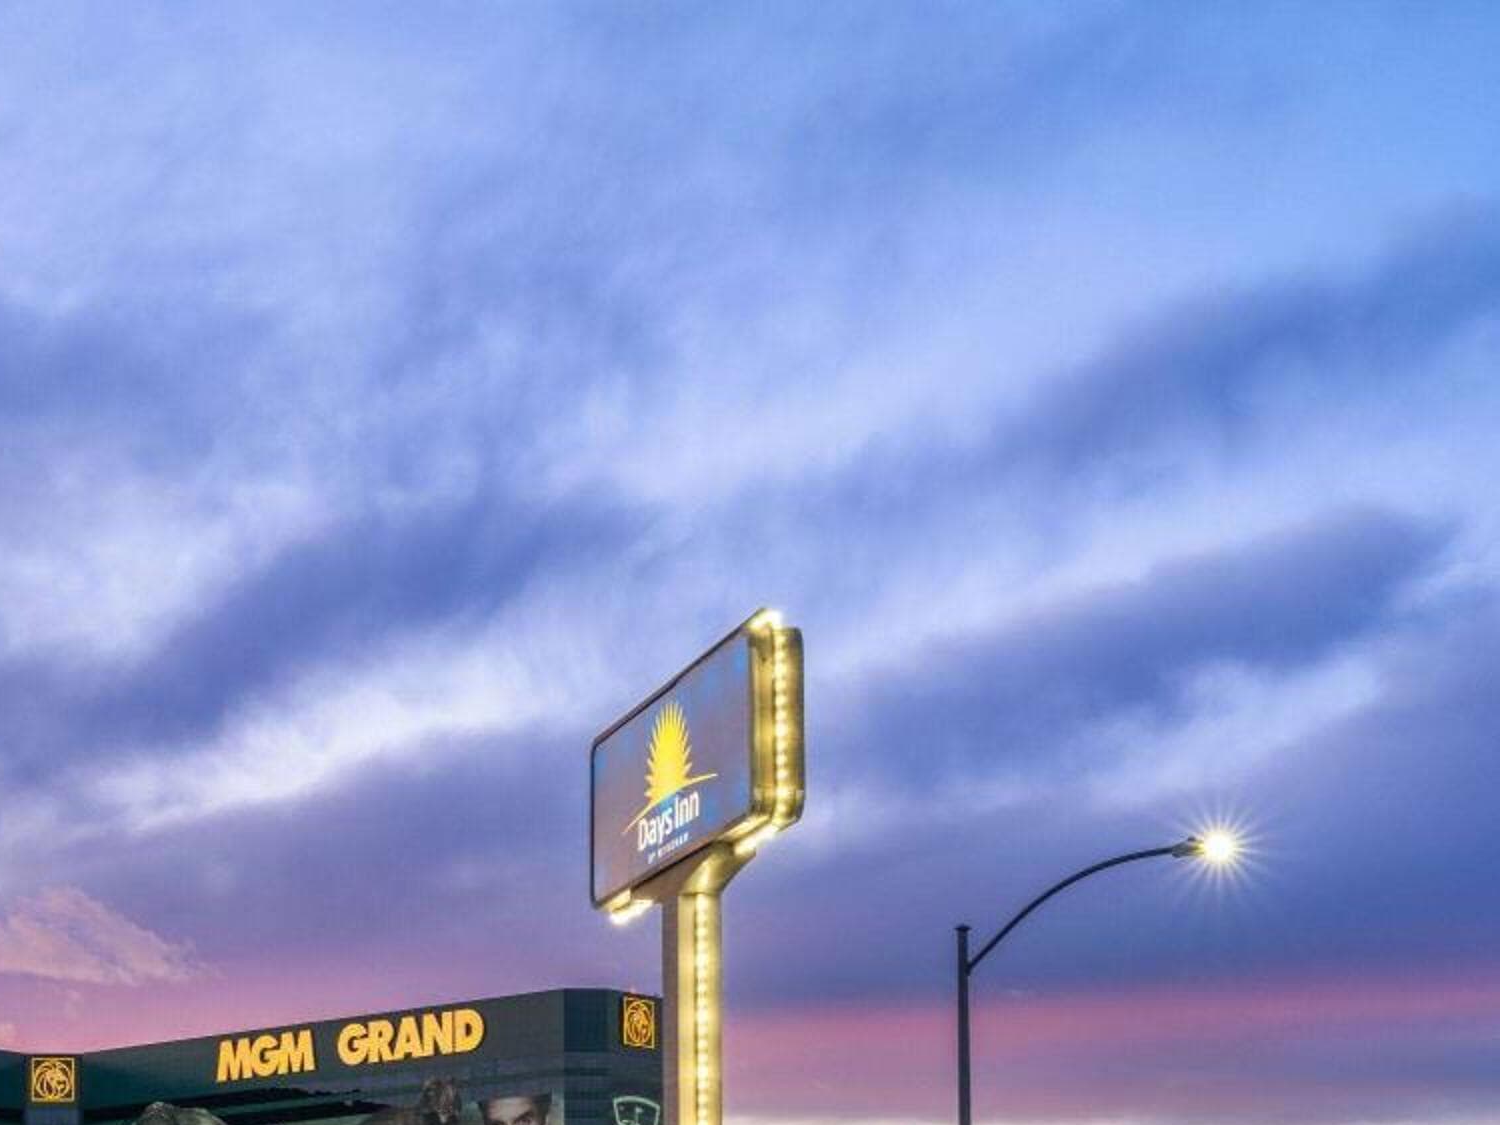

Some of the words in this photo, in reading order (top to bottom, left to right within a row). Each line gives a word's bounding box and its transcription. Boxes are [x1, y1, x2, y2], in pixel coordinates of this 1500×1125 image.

[637, 807, 673, 852] Days
[675, 791, 699, 829] Inn
[216, 1029, 316, 1083] MGM
[337, 1008, 485, 1066] GRAND
